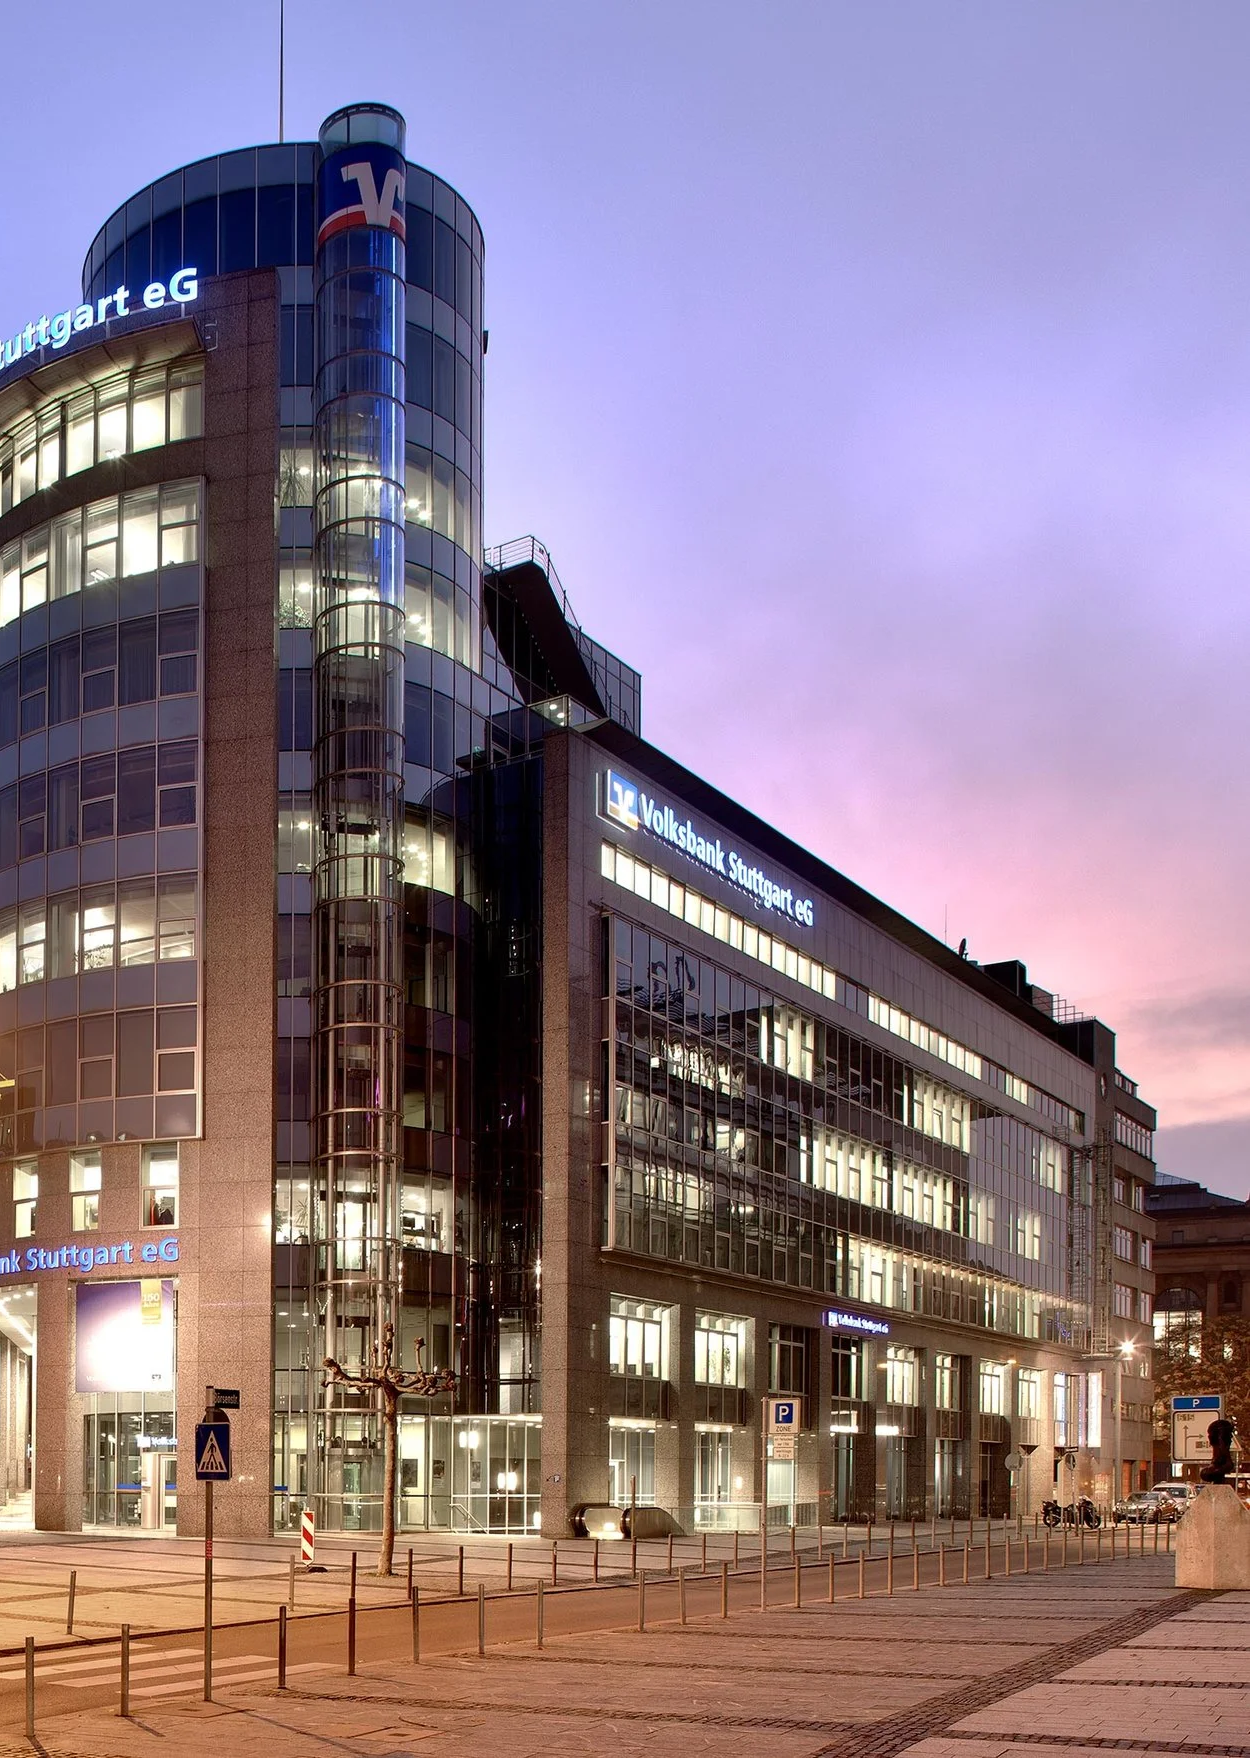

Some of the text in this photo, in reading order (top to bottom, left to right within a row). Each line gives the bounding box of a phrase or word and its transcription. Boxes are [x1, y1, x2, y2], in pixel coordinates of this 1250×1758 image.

[143, 266, 198, 309] eG
[639, 792, 814, 927] Volksbank Stuttgart eG
[26, 1240, 133, 1272] Stuttgart
[141, 1237, 179, 1262] eG
[779, 1405, 789, 1422] P
[1192, 1398, 1200, 1408] P
